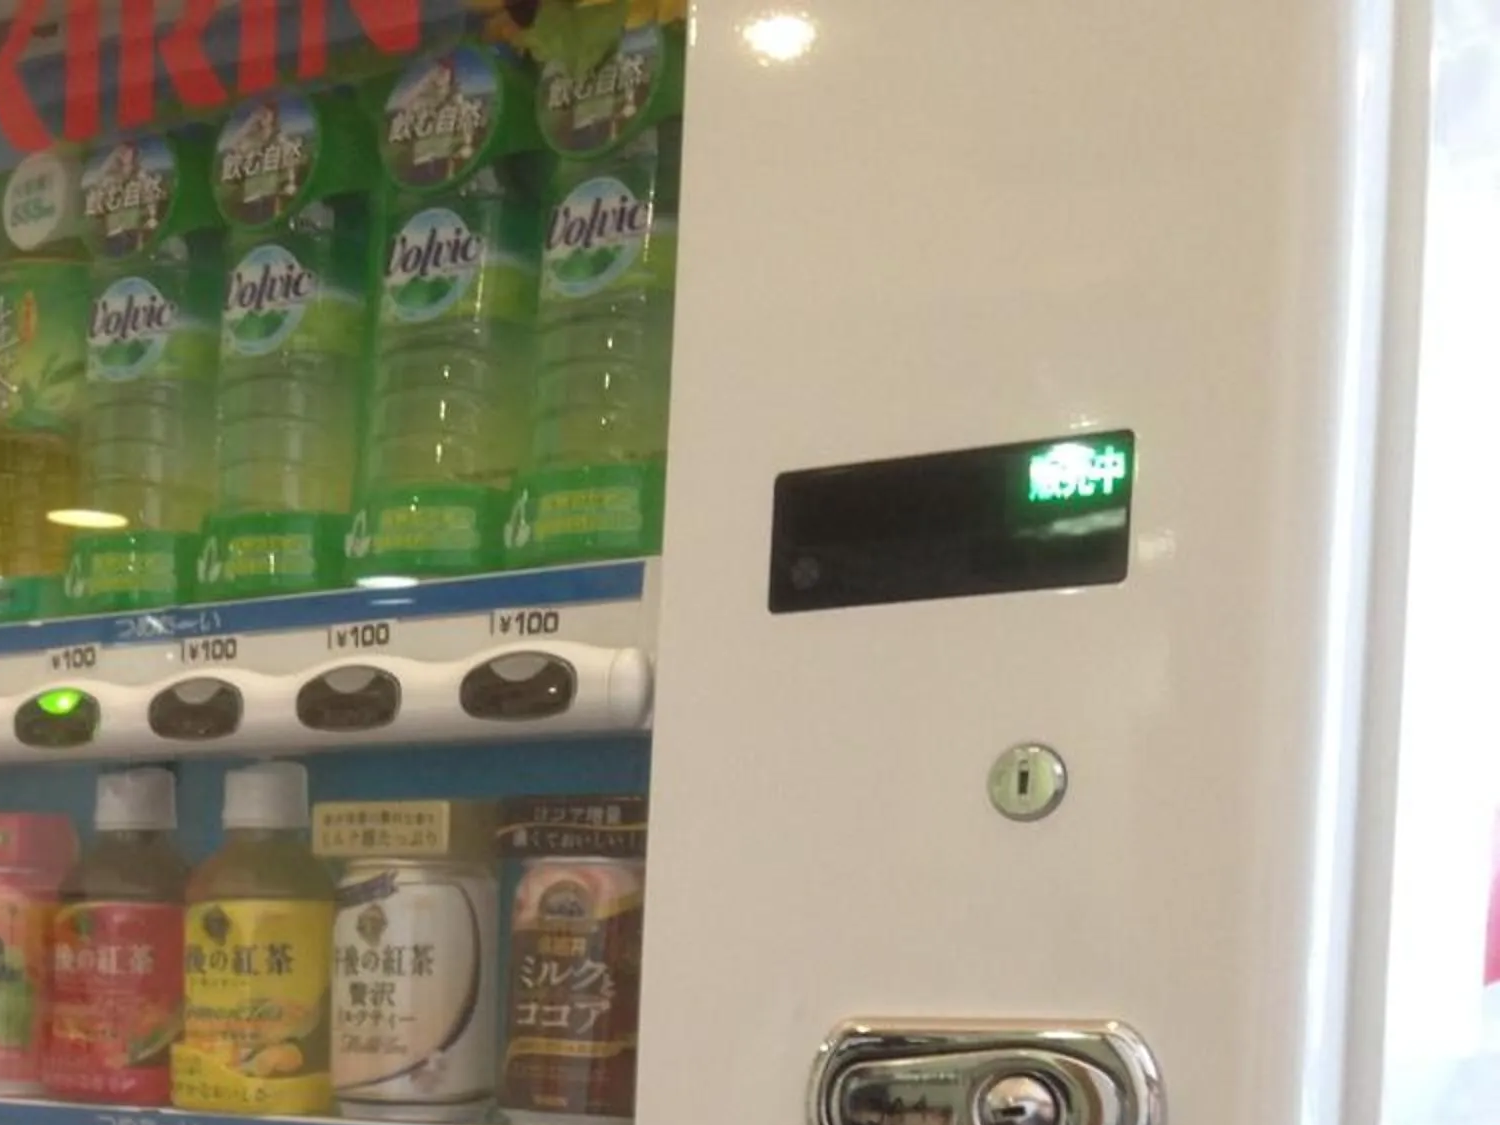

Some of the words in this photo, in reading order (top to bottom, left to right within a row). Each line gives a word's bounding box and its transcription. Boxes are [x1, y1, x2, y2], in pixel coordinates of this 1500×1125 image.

[389, 98, 483, 142] 飲む自然
[221, 138, 304, 182] 飲む自然
[547, 196, 647, 250] Volvic
[387, 228, 482, 277] Volvic
[227, 262, 311, 311] Volvic
[88, 293, 176, 339] Volvic
[337, 623, 391, 647] ¥100
[500, 611, 560, 635] ¥100
[51, 647, 97, 671] ¥100
[189, 638, 238, 661] ¥100
[516, 999, 612, 1035] ココア
